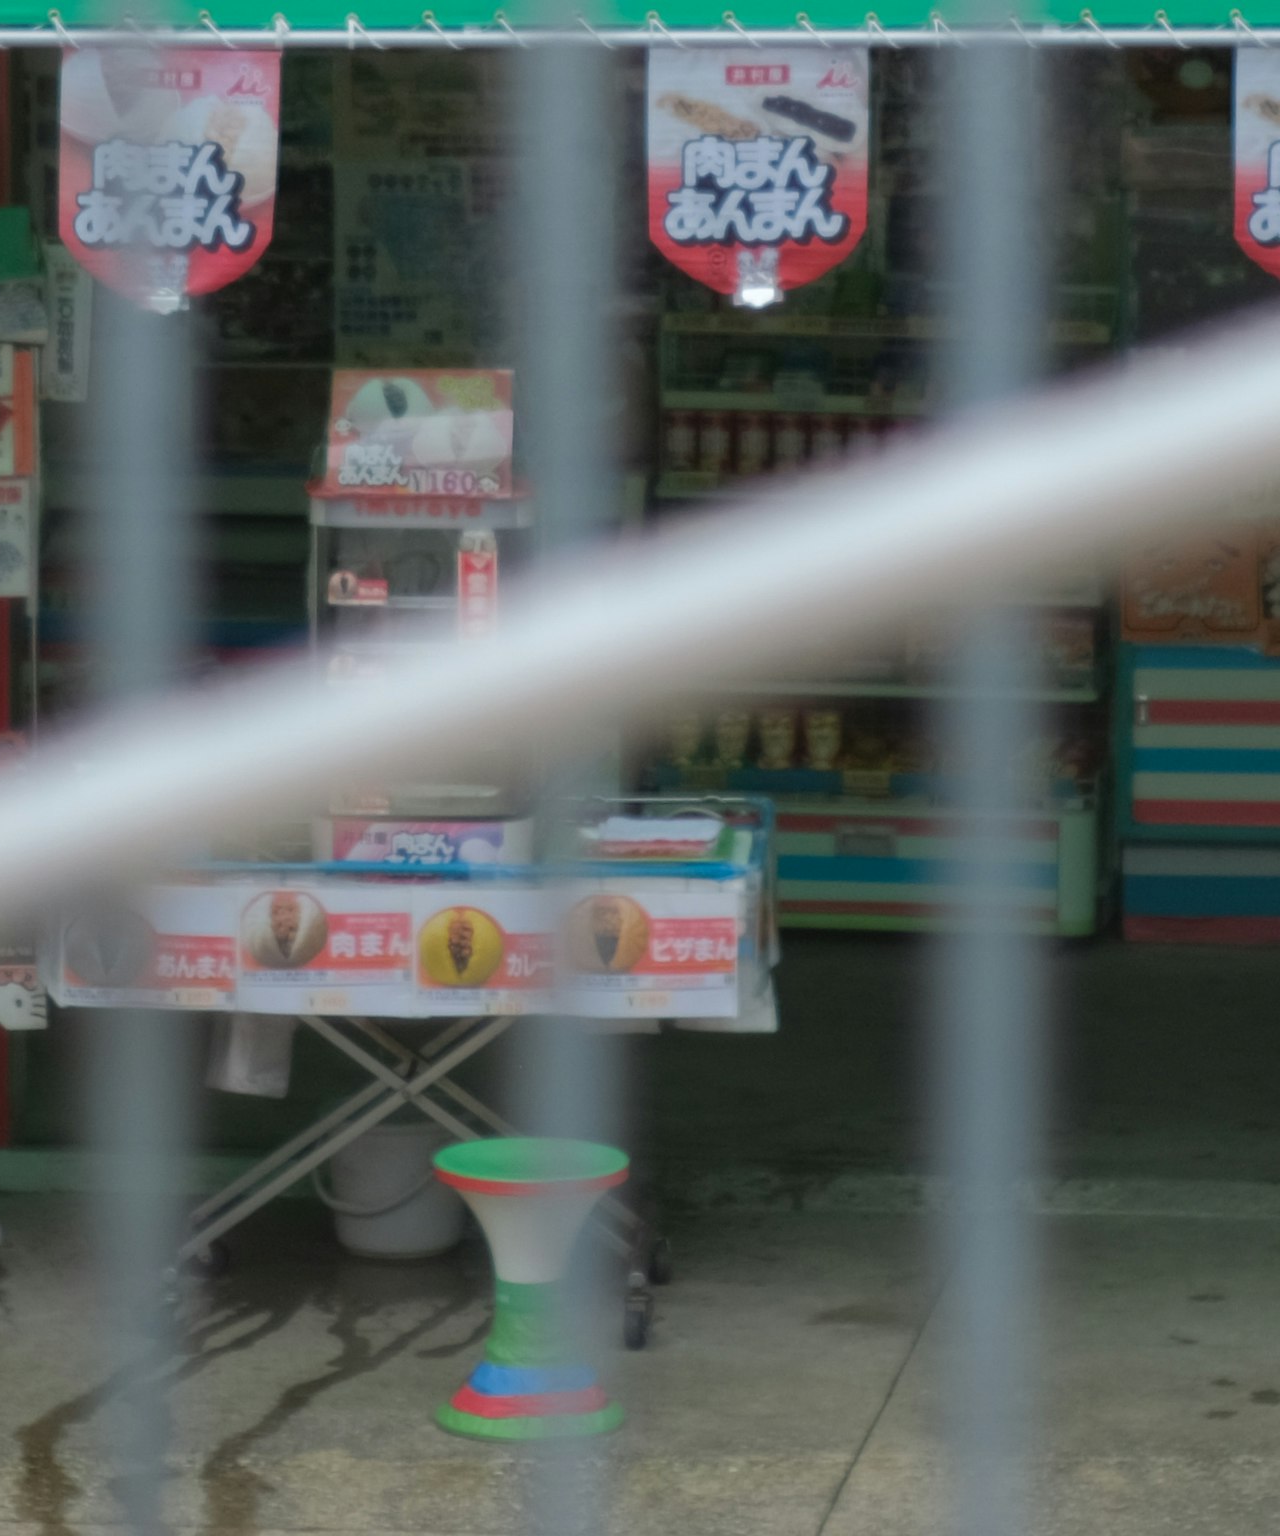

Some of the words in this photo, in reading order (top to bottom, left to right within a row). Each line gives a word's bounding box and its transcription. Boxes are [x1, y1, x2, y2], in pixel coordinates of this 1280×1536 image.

[94, 140, 235, 195] 肉まん
[683, 135, 828, 189] 肉まん
[74, 191, 250, 247] あんまん
[664, 188, 844, 242] あんまん
[157, 954, 234, 979] あんまん
[330, 932, 411, 958] 肉まん
[651, 938, 736, 962] ピザまん
